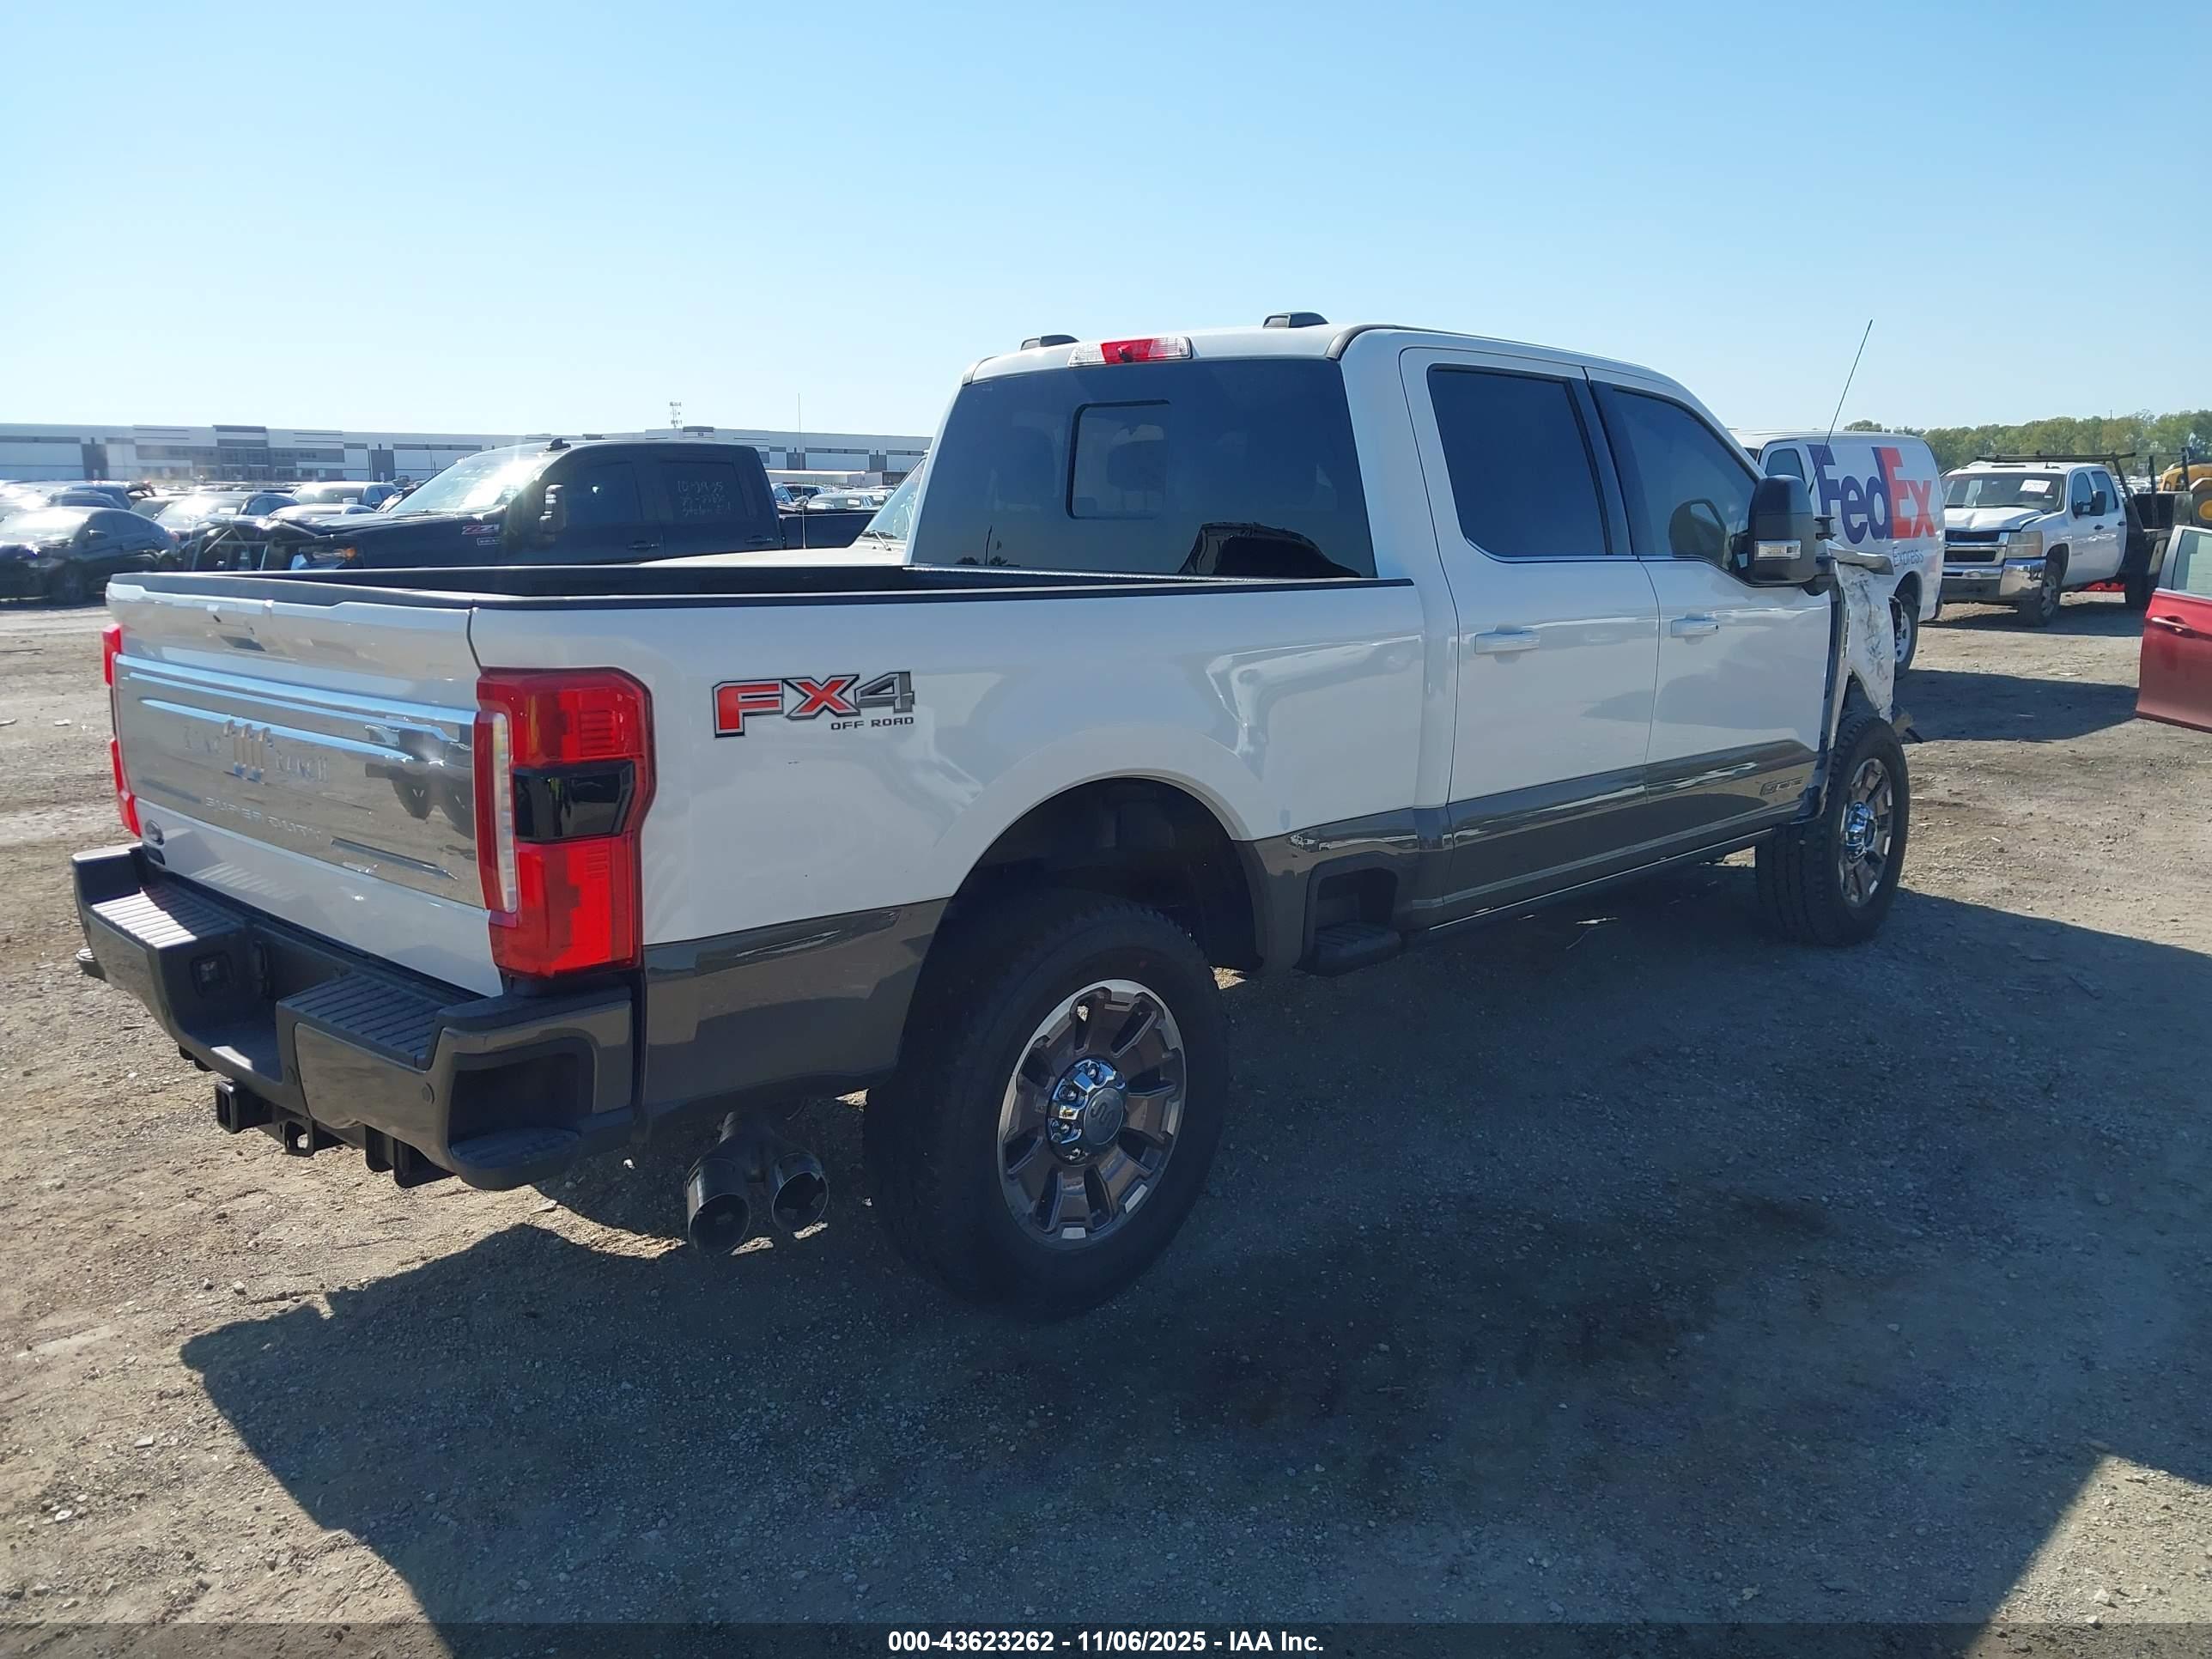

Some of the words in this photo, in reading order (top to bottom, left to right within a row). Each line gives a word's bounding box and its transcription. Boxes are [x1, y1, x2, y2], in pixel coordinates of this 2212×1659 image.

[1806, 444, 1936, 544] FedEx
[1892, 546, 1924, 568] Express
[713, 671, 915, 738] FX4
[830, 720, 866, 731] OFF
[871, 716, 915, 728] ROAD
[205, 796, 265, 823] SUPER
